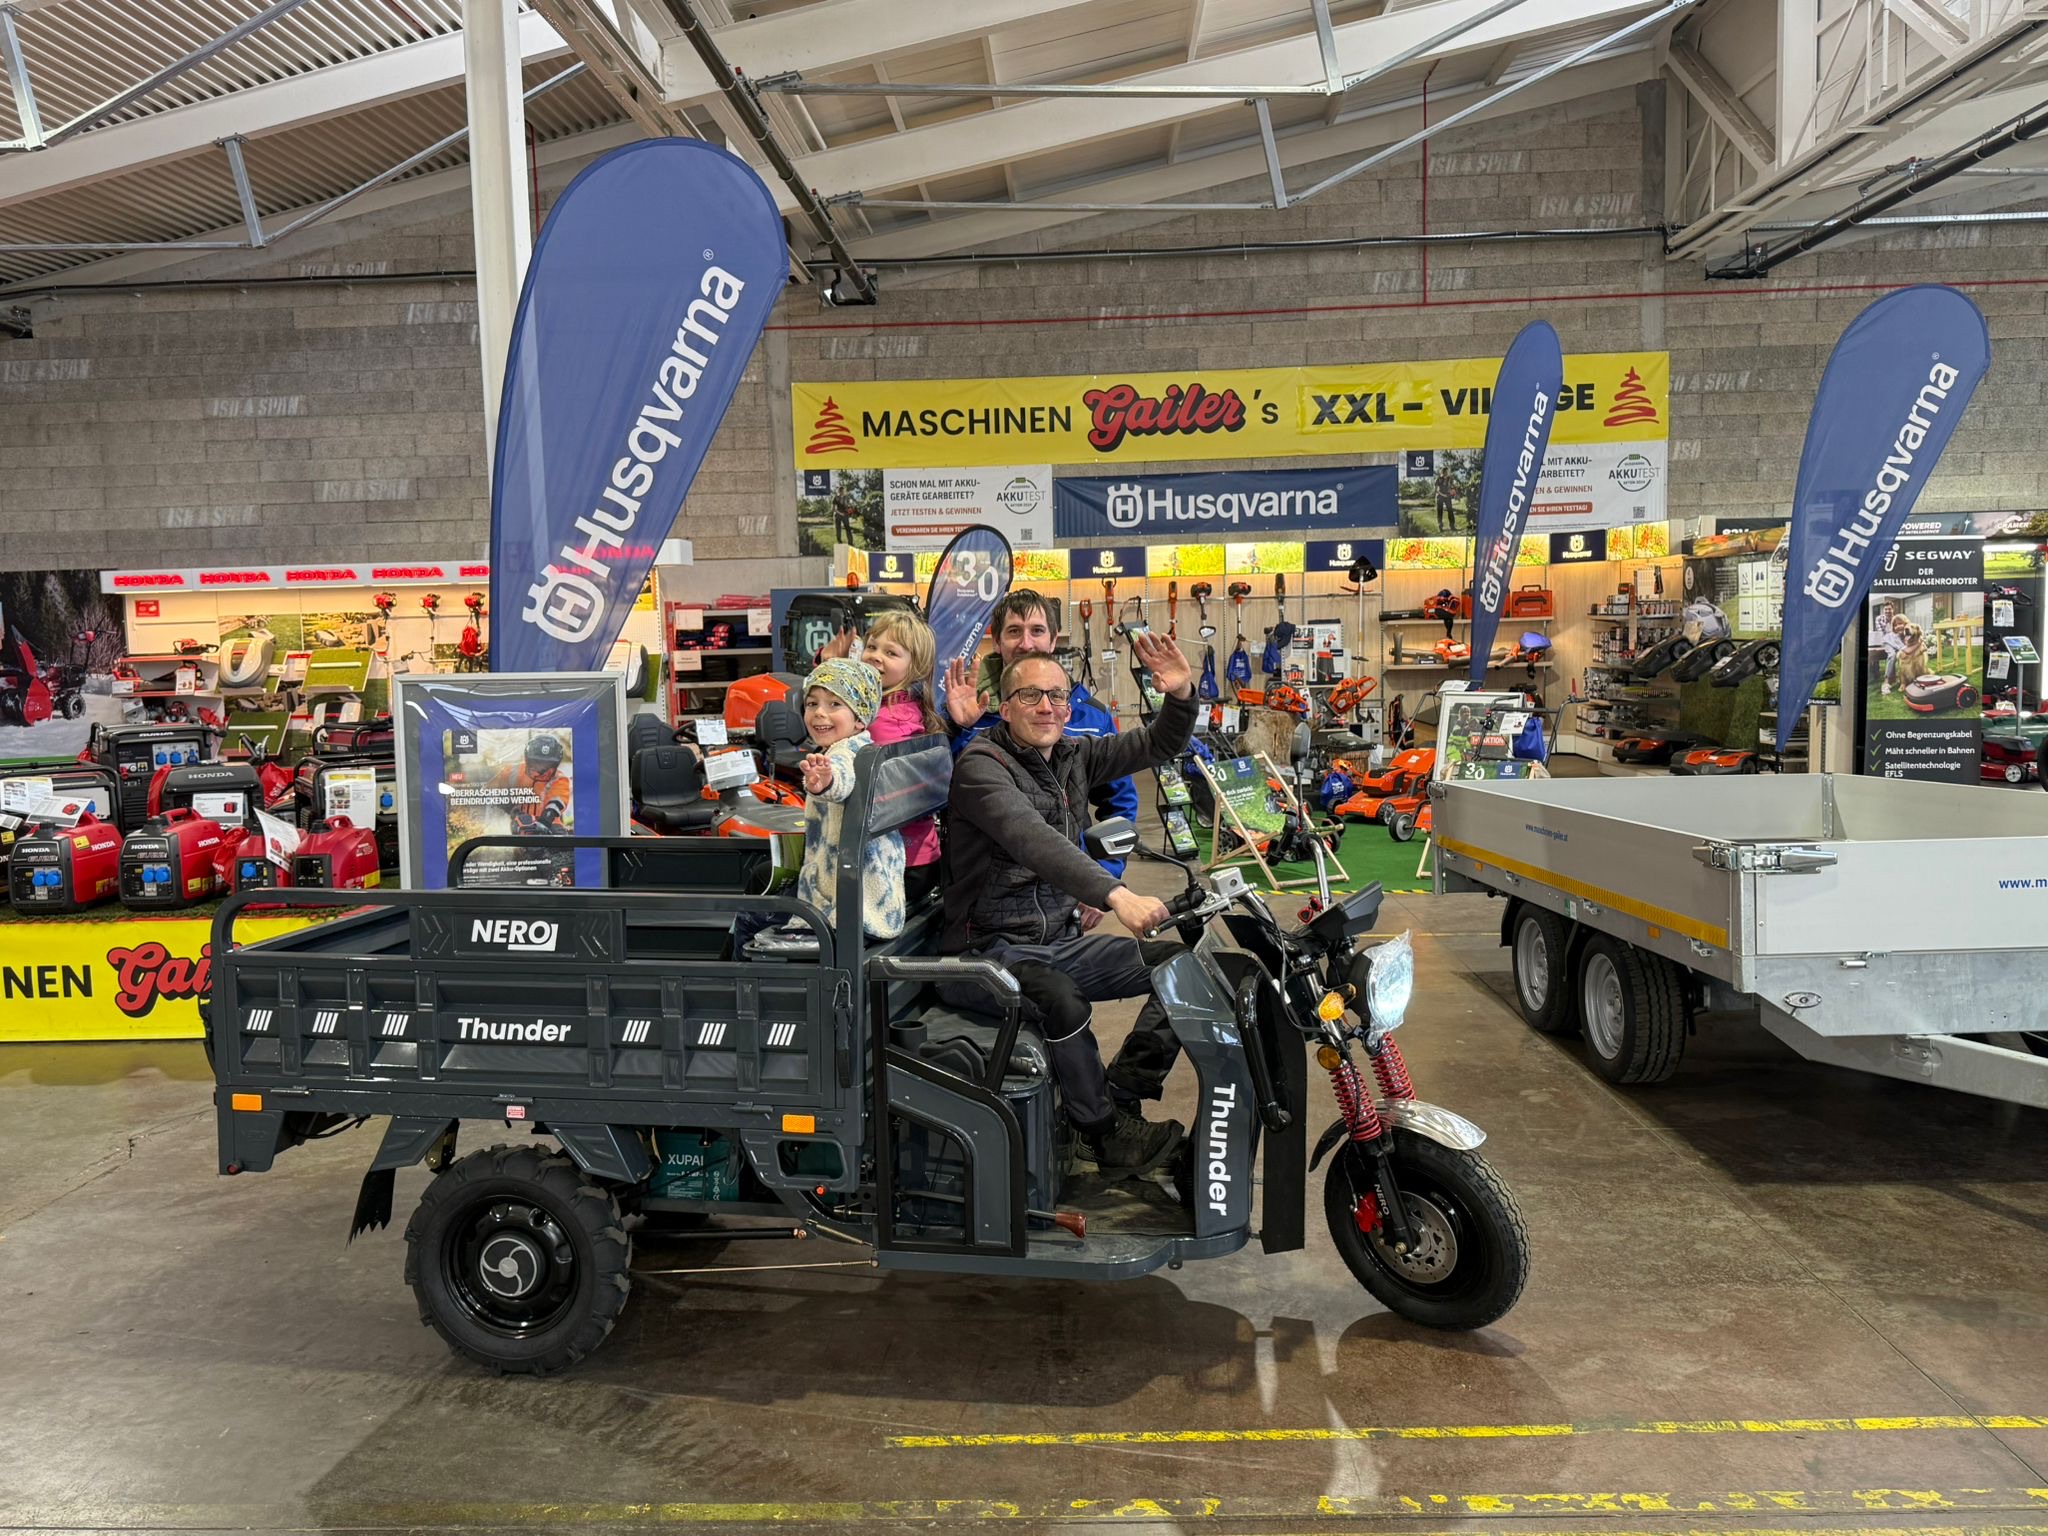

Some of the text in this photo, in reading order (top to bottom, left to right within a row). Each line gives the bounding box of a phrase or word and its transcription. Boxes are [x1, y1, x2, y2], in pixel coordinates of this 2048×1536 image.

[862, 405, 1072, 438] MASCHINEN
[1311, 392, 1395, 426] XXL
[1440, 383, 1595, 417] VILGE
[560, 263, 746, 579] Husqvarna
[1547, 456, 1592, 466] MIT AKKU-
[1837, 361, 1960, 568] Husqvarna
[1608, 467, 1661, 480] AKKUTEST
[890, 477, 981, 489] SCHON MAL MIT AKKU-
[1488, 391, 1550, 577] Husqvarna
[1546, 486, 1552, 495] &
[1554, 485, 1593, 494] GEWINNEN
[890, 490, 975, 502] GERÄTE GEARBEITET?
[996, 490, 1047, 502] AKKUTEST
[1147, 487, 1339, 524] Husqvarna
[890, 506, 982, 517] JETZT TESTEN & GEWINNEN
[1904, 551, 1973, 561] SEGWAY
[1918, 568, 1934, 576] DER
[1873, 577, 1978, 586] SATELLITENRASENROBOTER
[1886, 729, 1973, 740] Ohne Begrenzungskabel
[1885, 747, 1904, 755] Mäht
[1905, 747, 1938, 755] schneller
[1947, 746, 1975, 754] Bahnen
[1885, 761, 1961, 771] Satellitentechnologie
[188, 771, 235, 779] HONDA
[1884, 770, 1904, 778] EFLS
[509, 787, 536, 796] STARK.
[450, 796, 542, 806] BEEINDRUCKEND WENDIG.
[92, 841, 116, 851] HONDA
[472, 919, 558, 951] NERO
[458, 1018, 571, 1042] Thunder
[1207, 1083, 1236, 1217] Thunder
[668, 1154, 704, 1166] XUPAI
[1374, 1184, 1390, 1215] NERO
